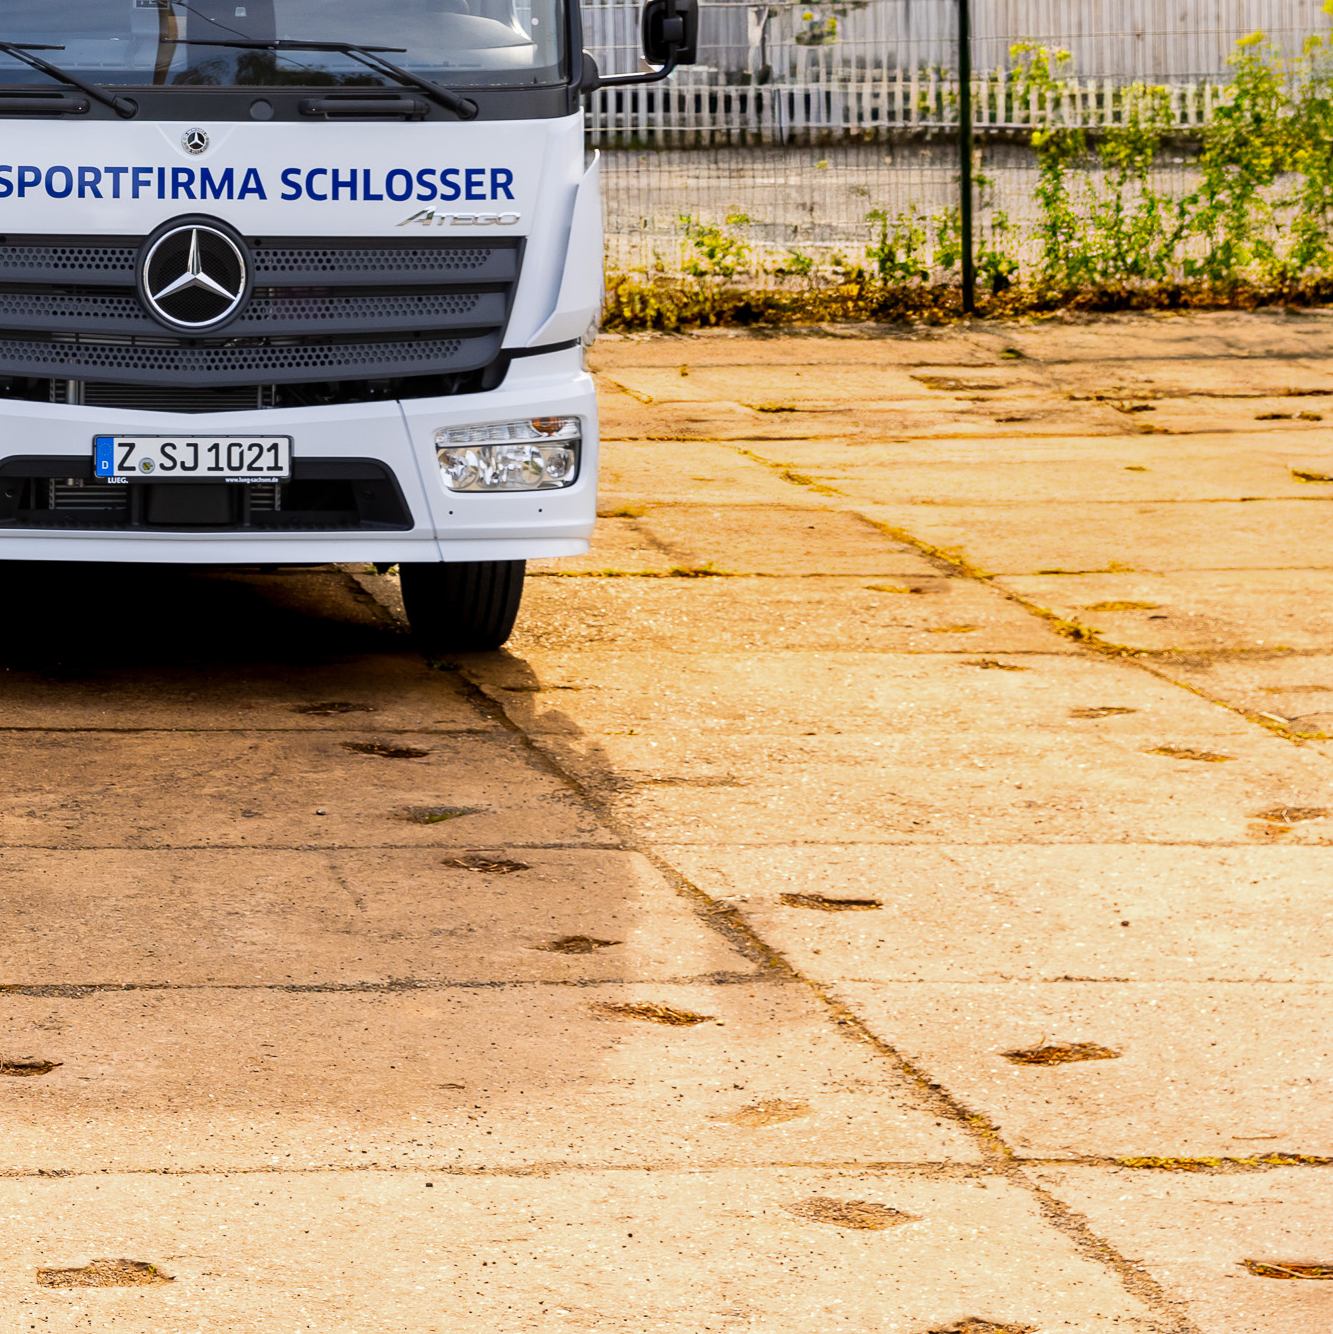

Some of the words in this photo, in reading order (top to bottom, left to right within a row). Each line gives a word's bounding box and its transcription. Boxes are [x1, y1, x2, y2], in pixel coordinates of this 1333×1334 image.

[280, 166, 515, 202] SCHLOSSER
[101, 460, 109, 470] D
[117, 442, 136, 472] Z
